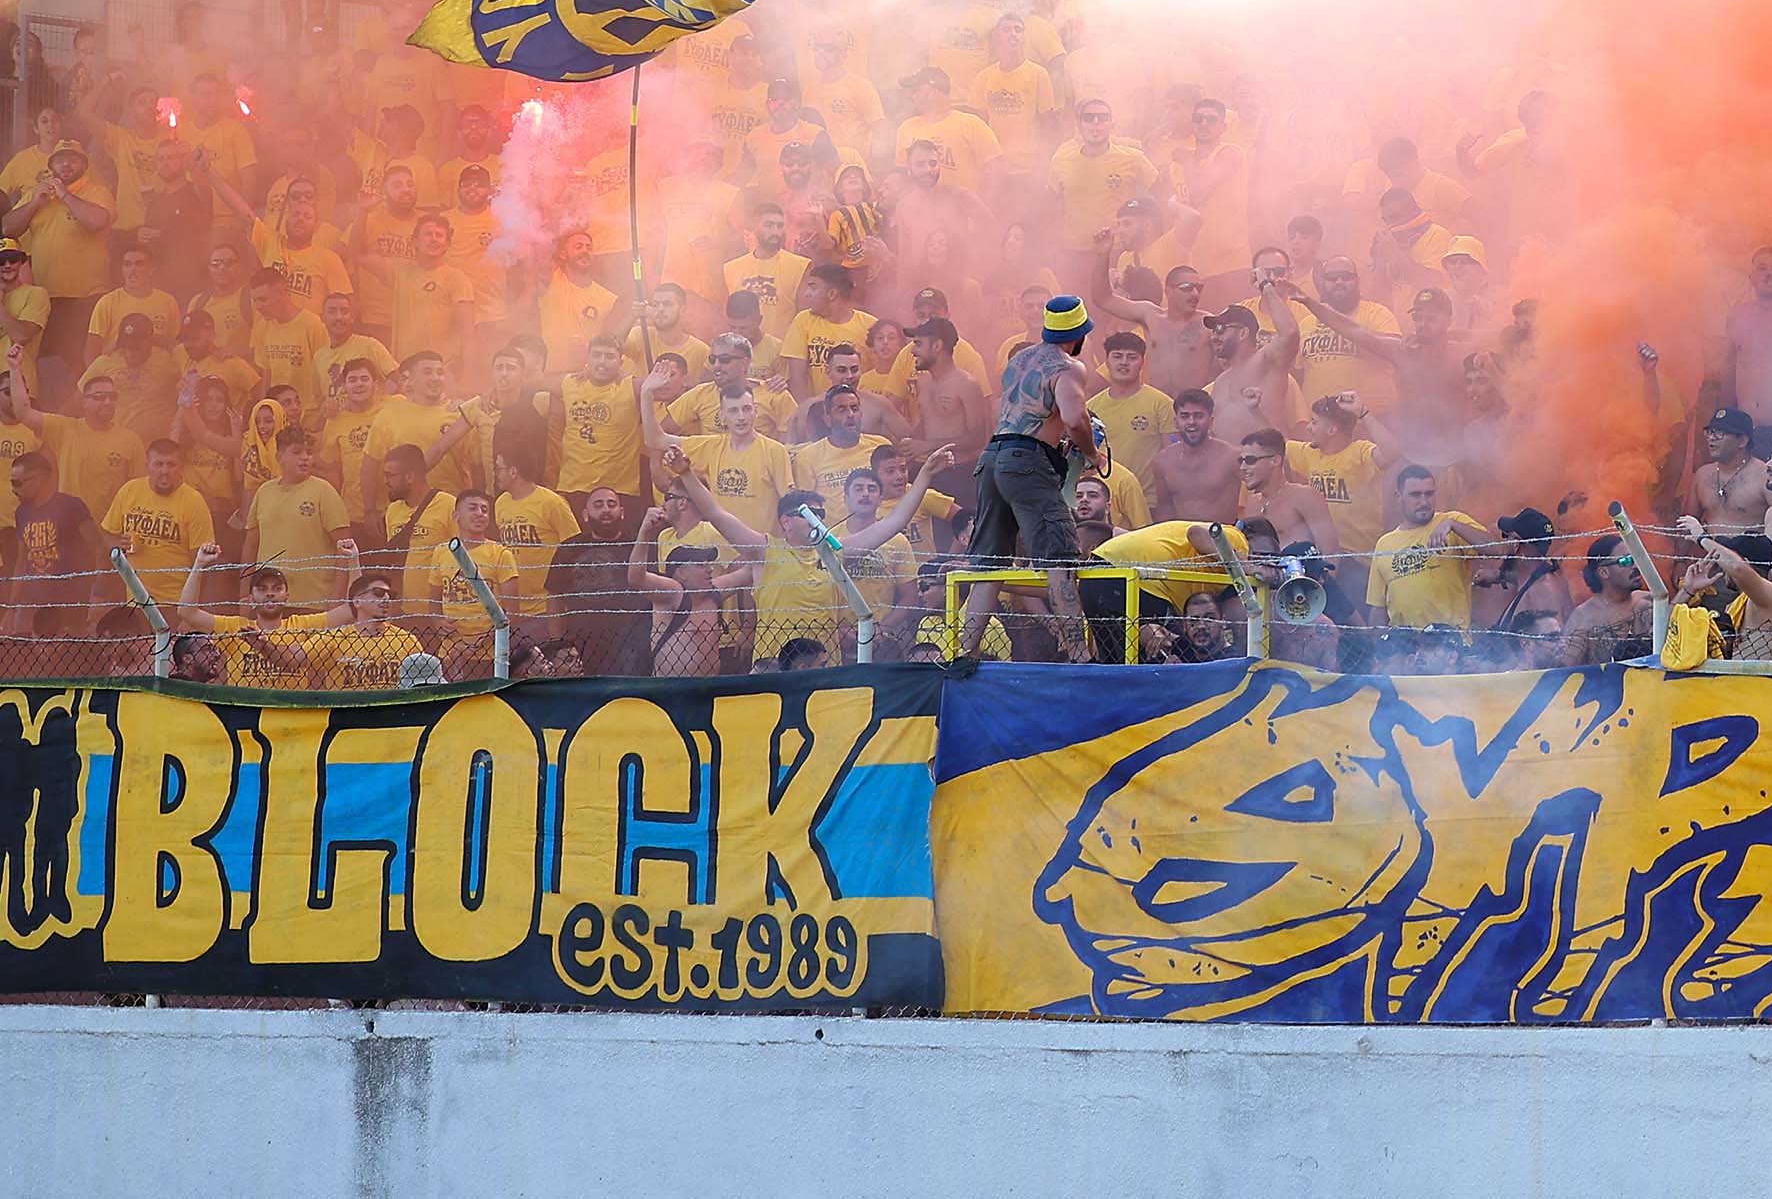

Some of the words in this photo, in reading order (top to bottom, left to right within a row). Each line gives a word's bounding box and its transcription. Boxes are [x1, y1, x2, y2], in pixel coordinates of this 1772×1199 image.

[377, 235, 416, 258] ΣΥΦΑ
[499, 525, 543, 544] ΦΑΕΛ
[342, 661, 400, 685] ΣΥΦΑΕ
[103, 688, 875, 963] BLOCK
